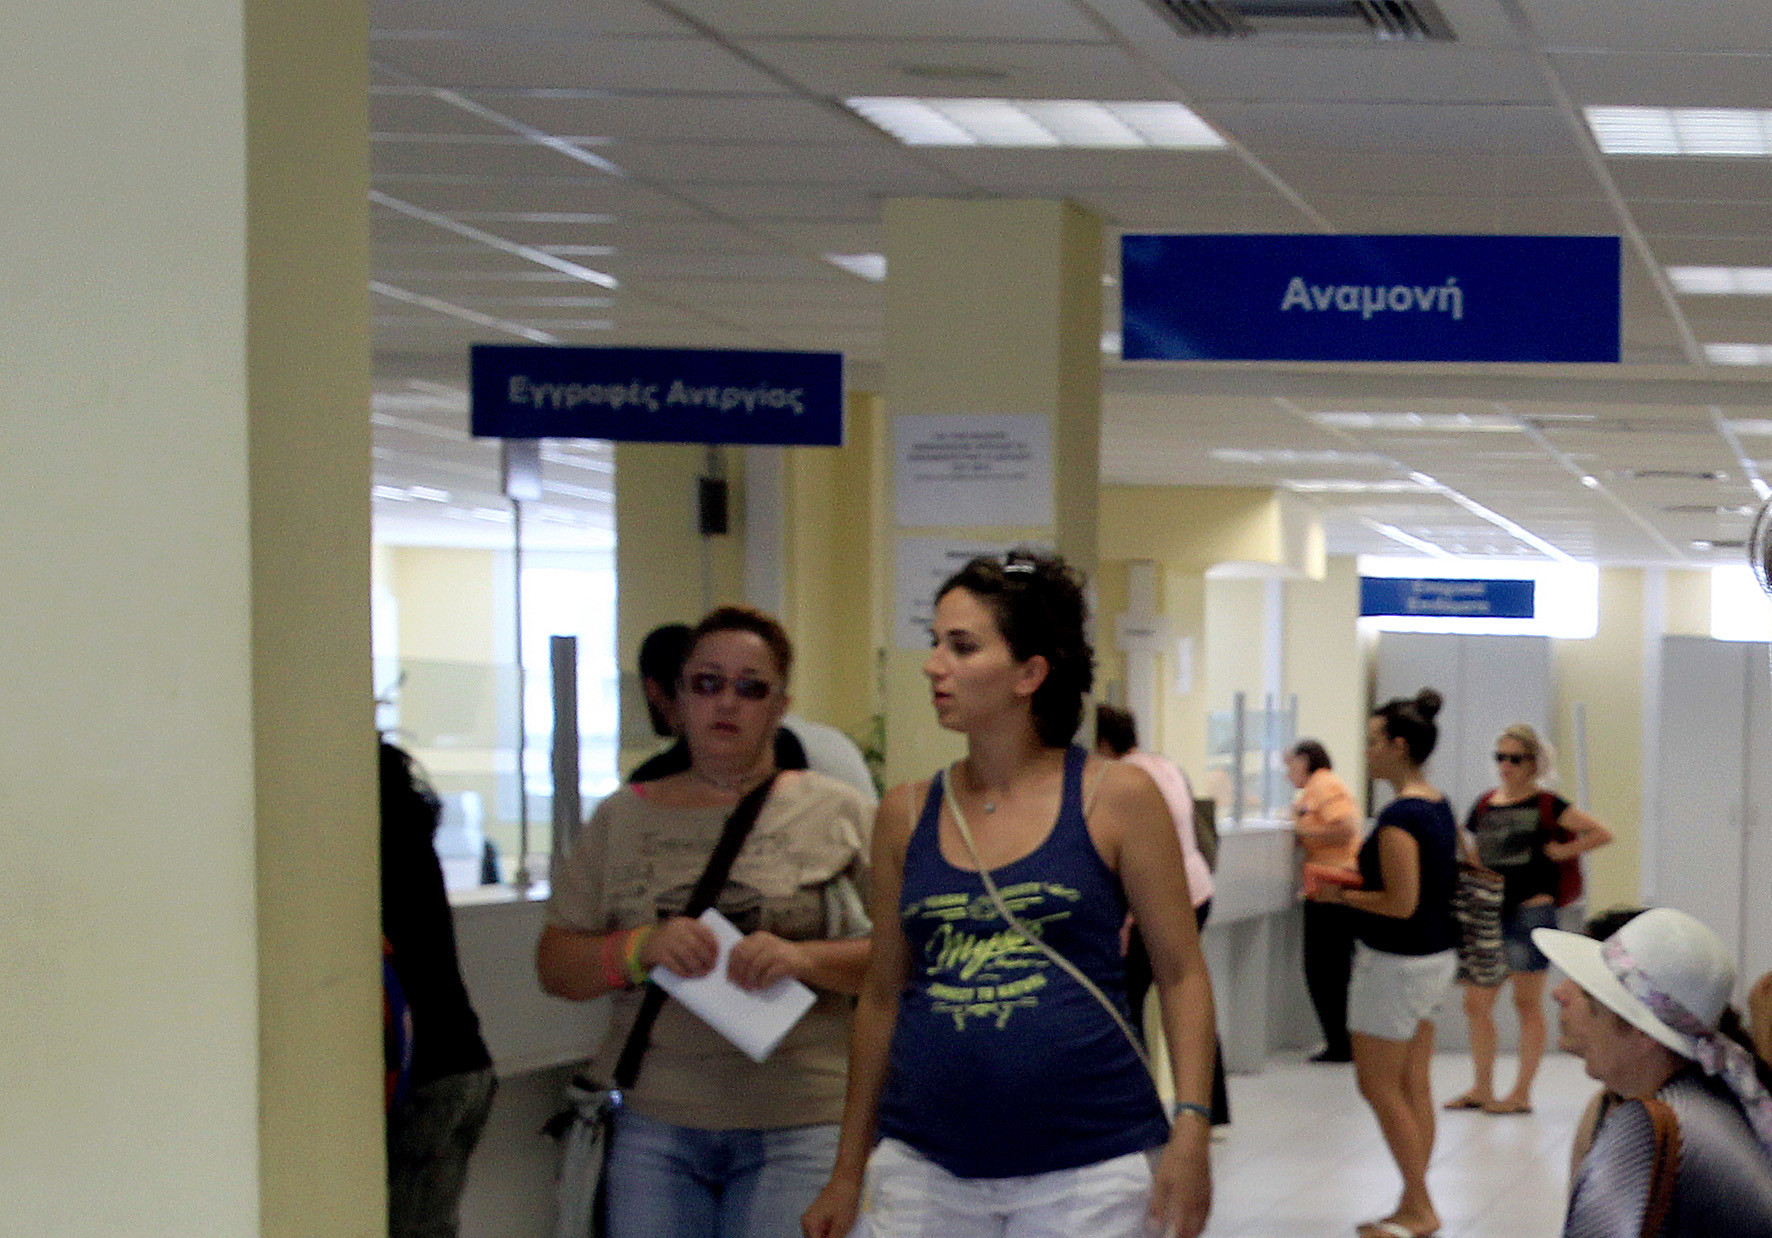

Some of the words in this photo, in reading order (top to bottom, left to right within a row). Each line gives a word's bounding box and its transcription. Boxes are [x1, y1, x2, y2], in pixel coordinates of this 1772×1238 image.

[1280, 276, 1464, 321] Αναμονή
[509, 375, 660, 413] Εγγραφές
[666, 380, 804, 415] Ανεργίας
